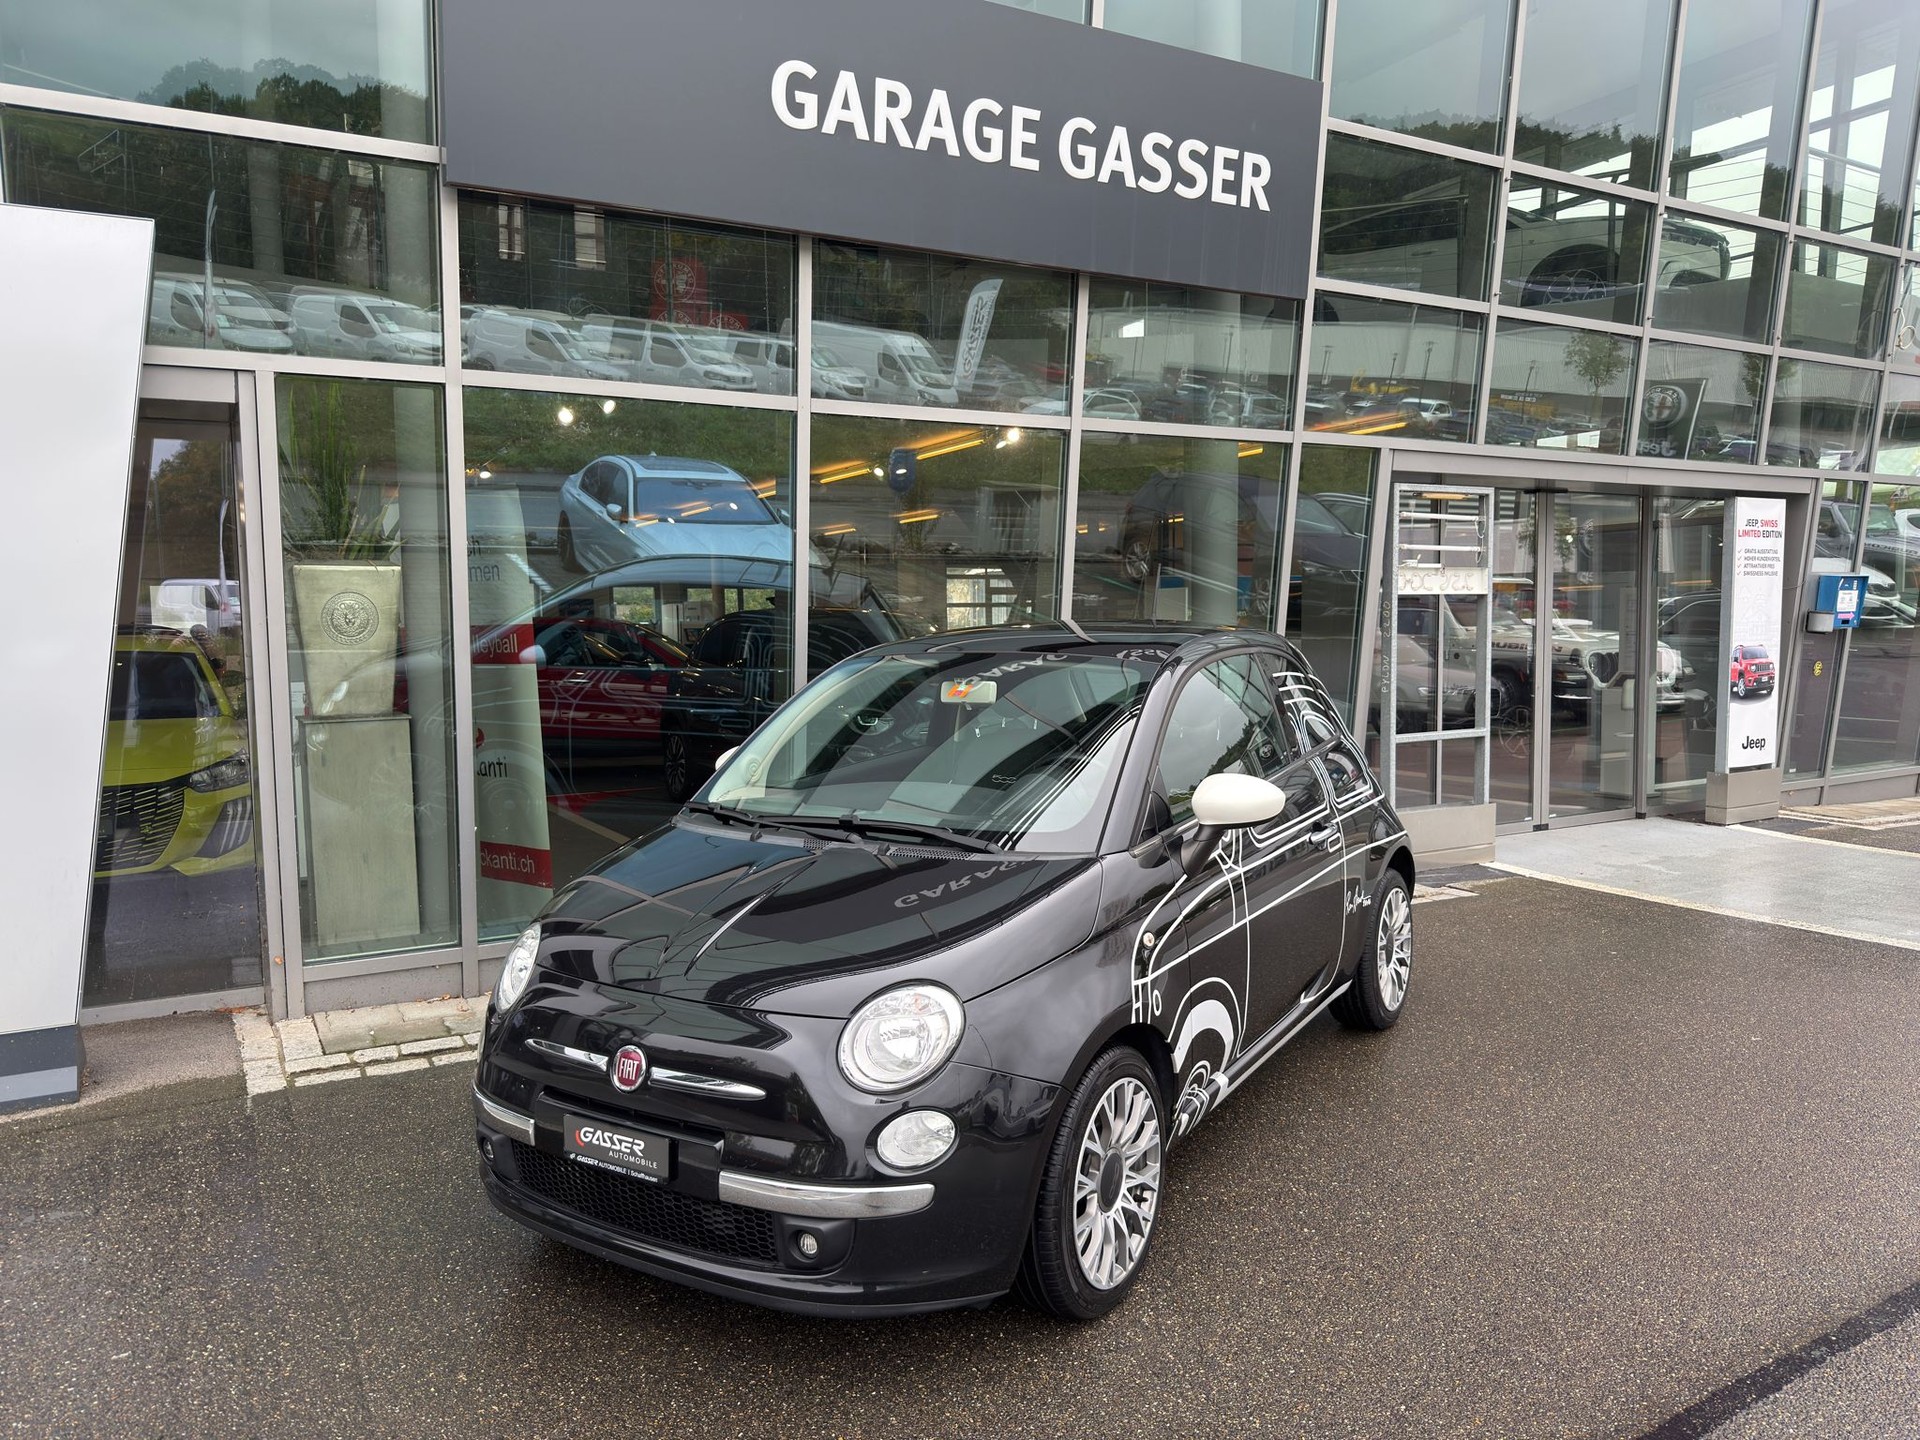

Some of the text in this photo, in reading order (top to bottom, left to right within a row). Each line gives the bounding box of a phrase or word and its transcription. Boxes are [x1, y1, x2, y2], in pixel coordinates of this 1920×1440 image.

[771, 60, 1271, 211] GARAGE GASSER
[1738, 529, 1761, 538] LIMITED
[1760, 519, 1778, 528] SWISS
[469, 564, 500, 582] men
[472, 633, 518, 658] lleyball
[1742, 735, 1766, 751] Jeep
[477, 756, 508, 778] anti
[481, 848, 535, 874] ckanti.ch
[619, 1057, 640, 1080] FIAT
[580, 1126, 645, 1157] GASSER
[577, 1155, 659, 1183] GASSER AUTOMOBILE Schaffhausen
[608, 1150, 658, 1169] AUTOMOBILE
